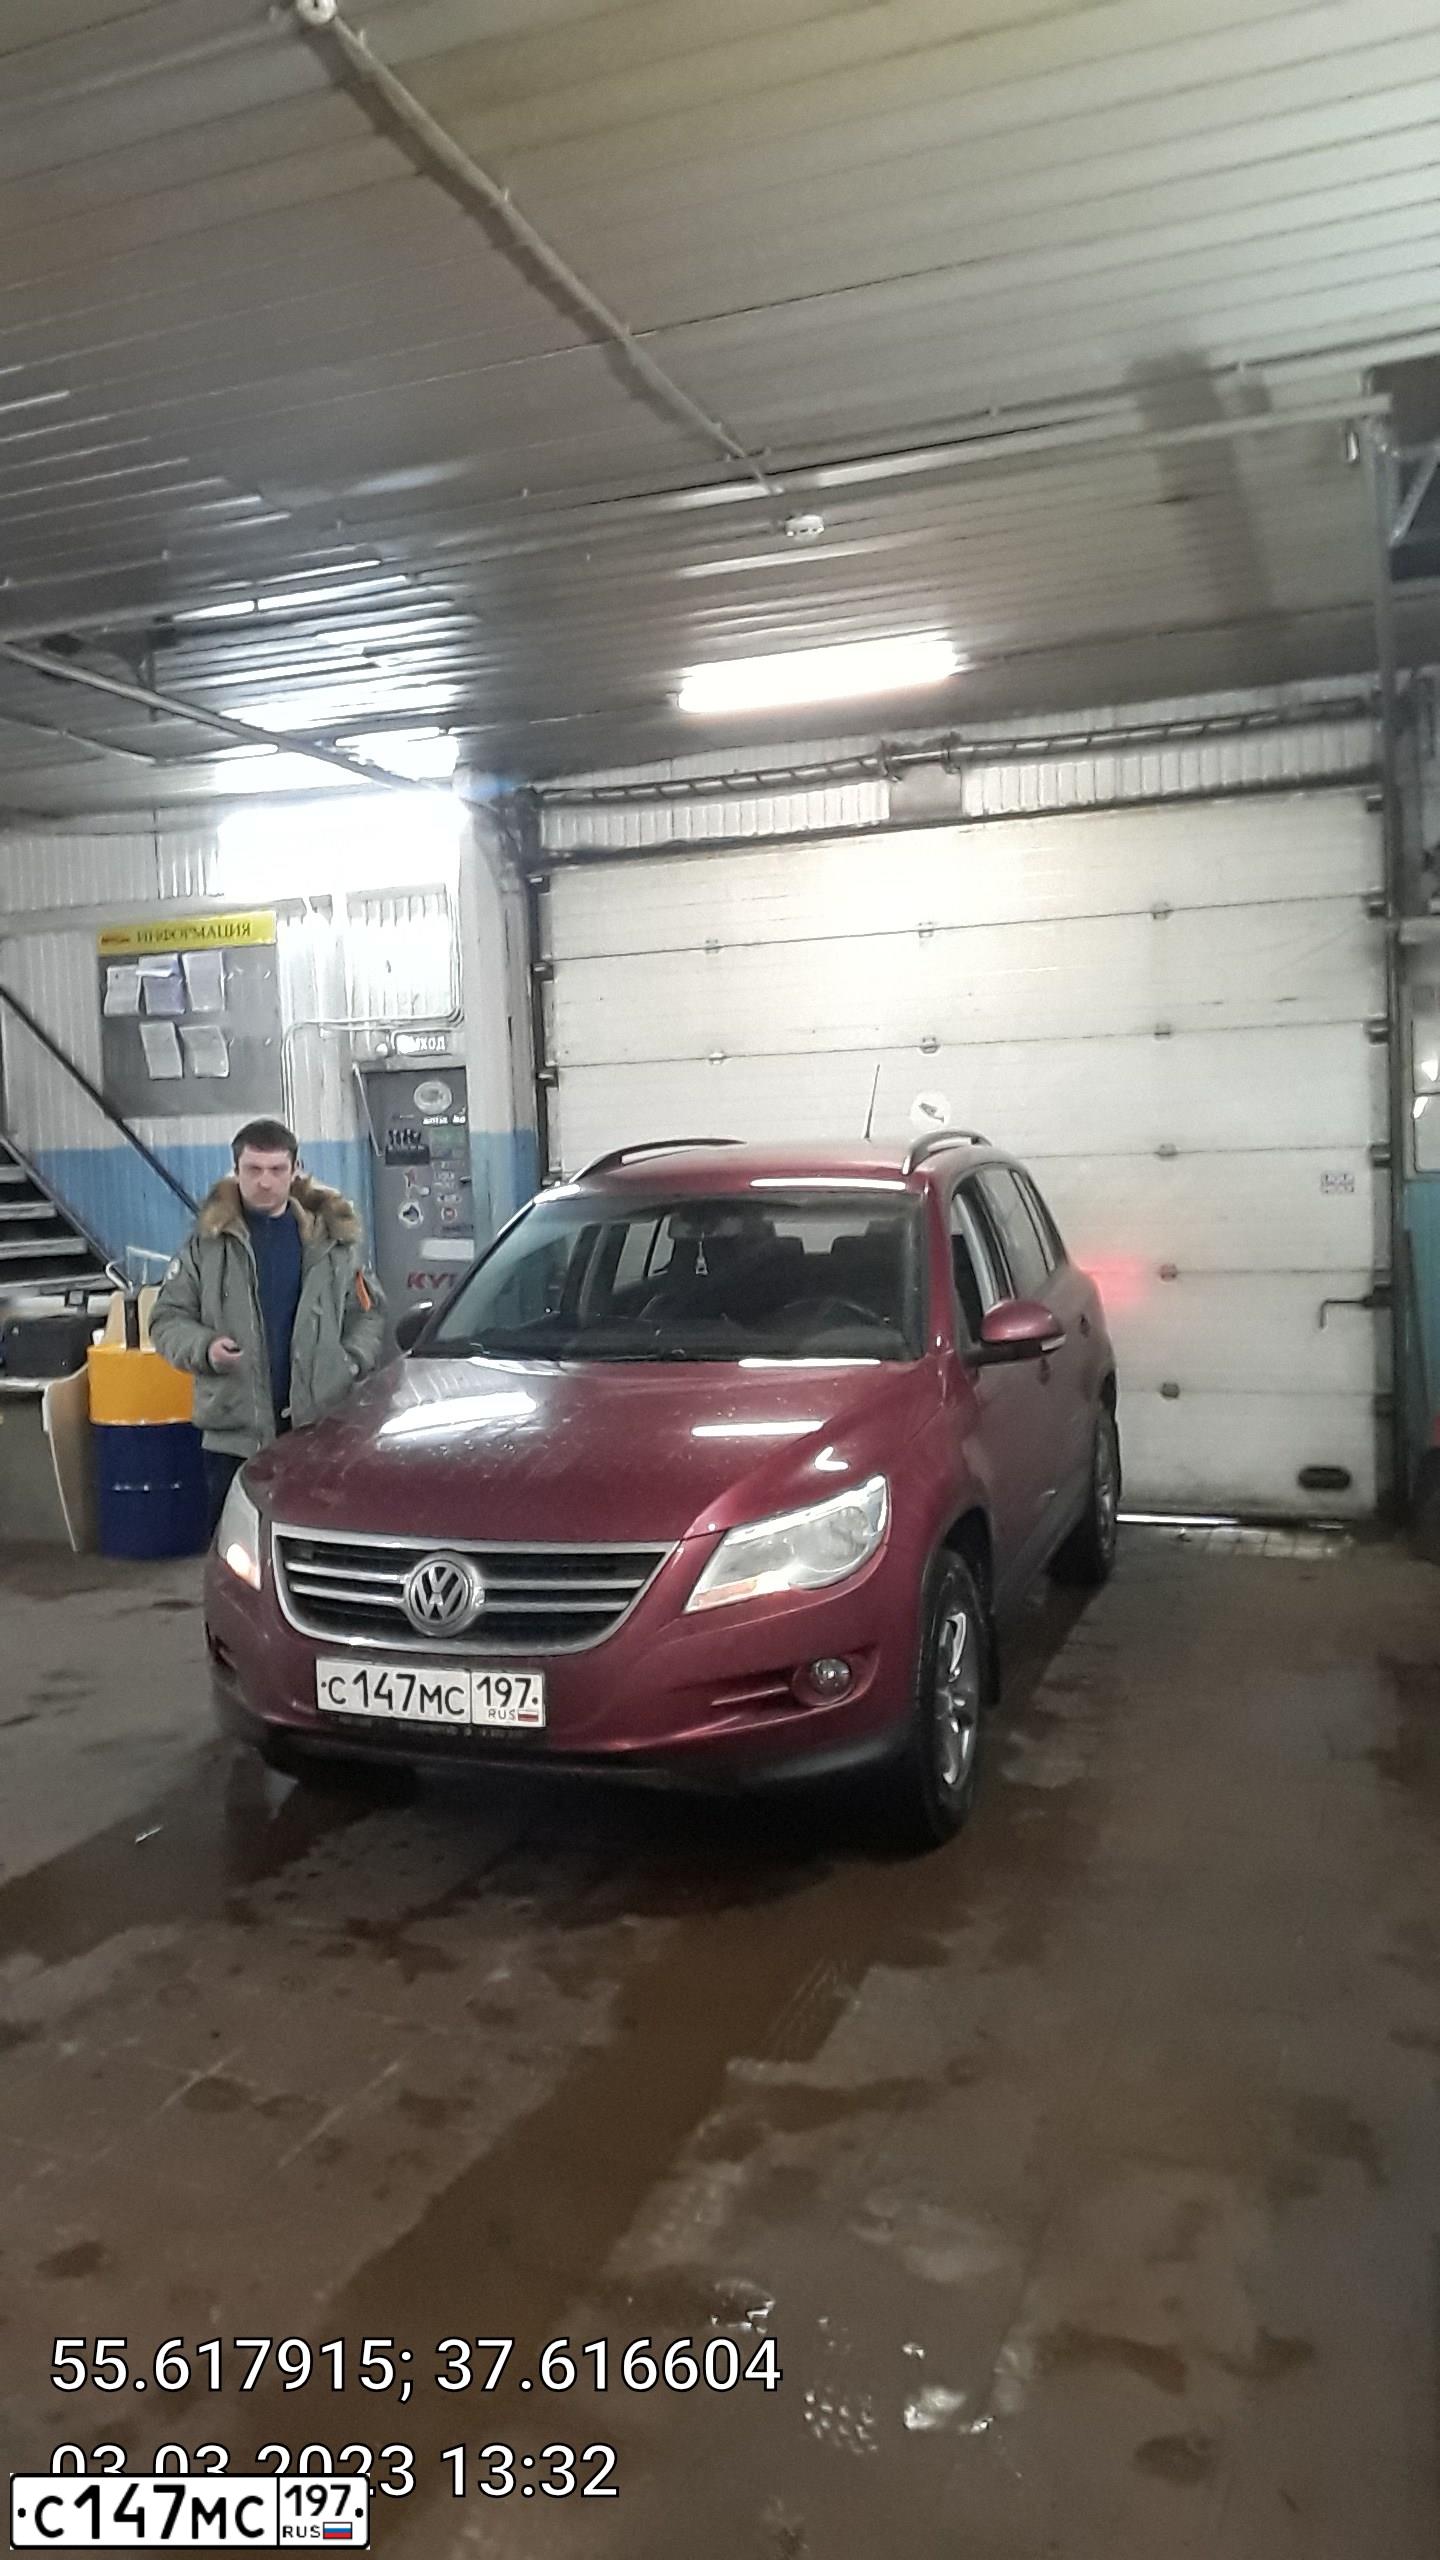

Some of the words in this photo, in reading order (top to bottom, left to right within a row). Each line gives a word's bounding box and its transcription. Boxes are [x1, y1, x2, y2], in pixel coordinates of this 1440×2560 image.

[137, 922, 251, 943] ИНФОРМАЦИЯ
[328, 1670, 465, 1716] С147МС
[476, 1676, 532, 1709] 197
[488, 1708, 516, 1720] RUS
